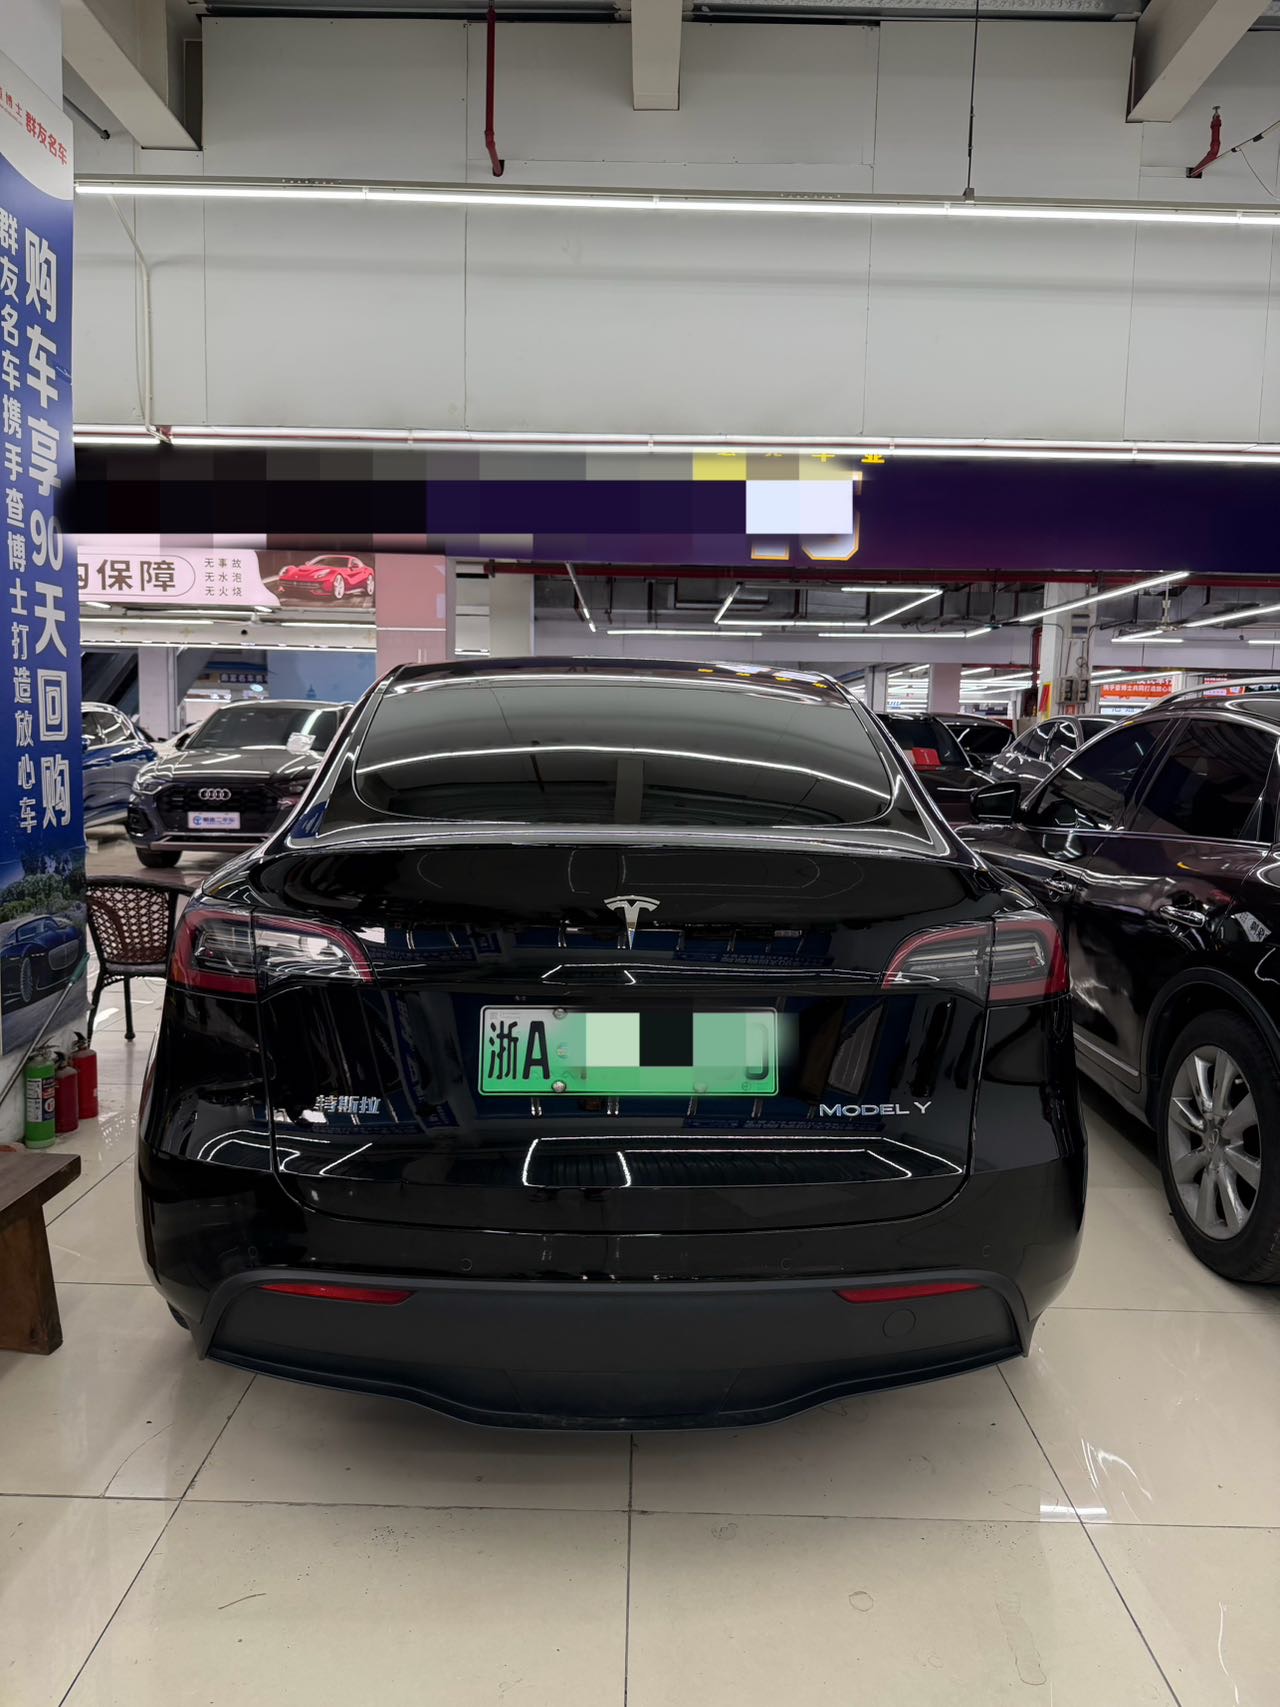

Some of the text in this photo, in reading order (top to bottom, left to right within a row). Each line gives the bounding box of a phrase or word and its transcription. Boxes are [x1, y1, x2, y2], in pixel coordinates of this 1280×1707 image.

[25, 110, 68, 166] 群友名车
[0, 207, 37, 833] 群友名车携手查博士打造放心车
[25, 227, 72, 829] 购车享90天回购
[204, 558, 242, 569] 无事故
[205, 572, 242, 583] 无水泡
[205, 586, 242, 597] 无火烧
[313, 1095, 381, 1114] 特斯拉
[819, 1101, 932, 1117] MODEL Y
